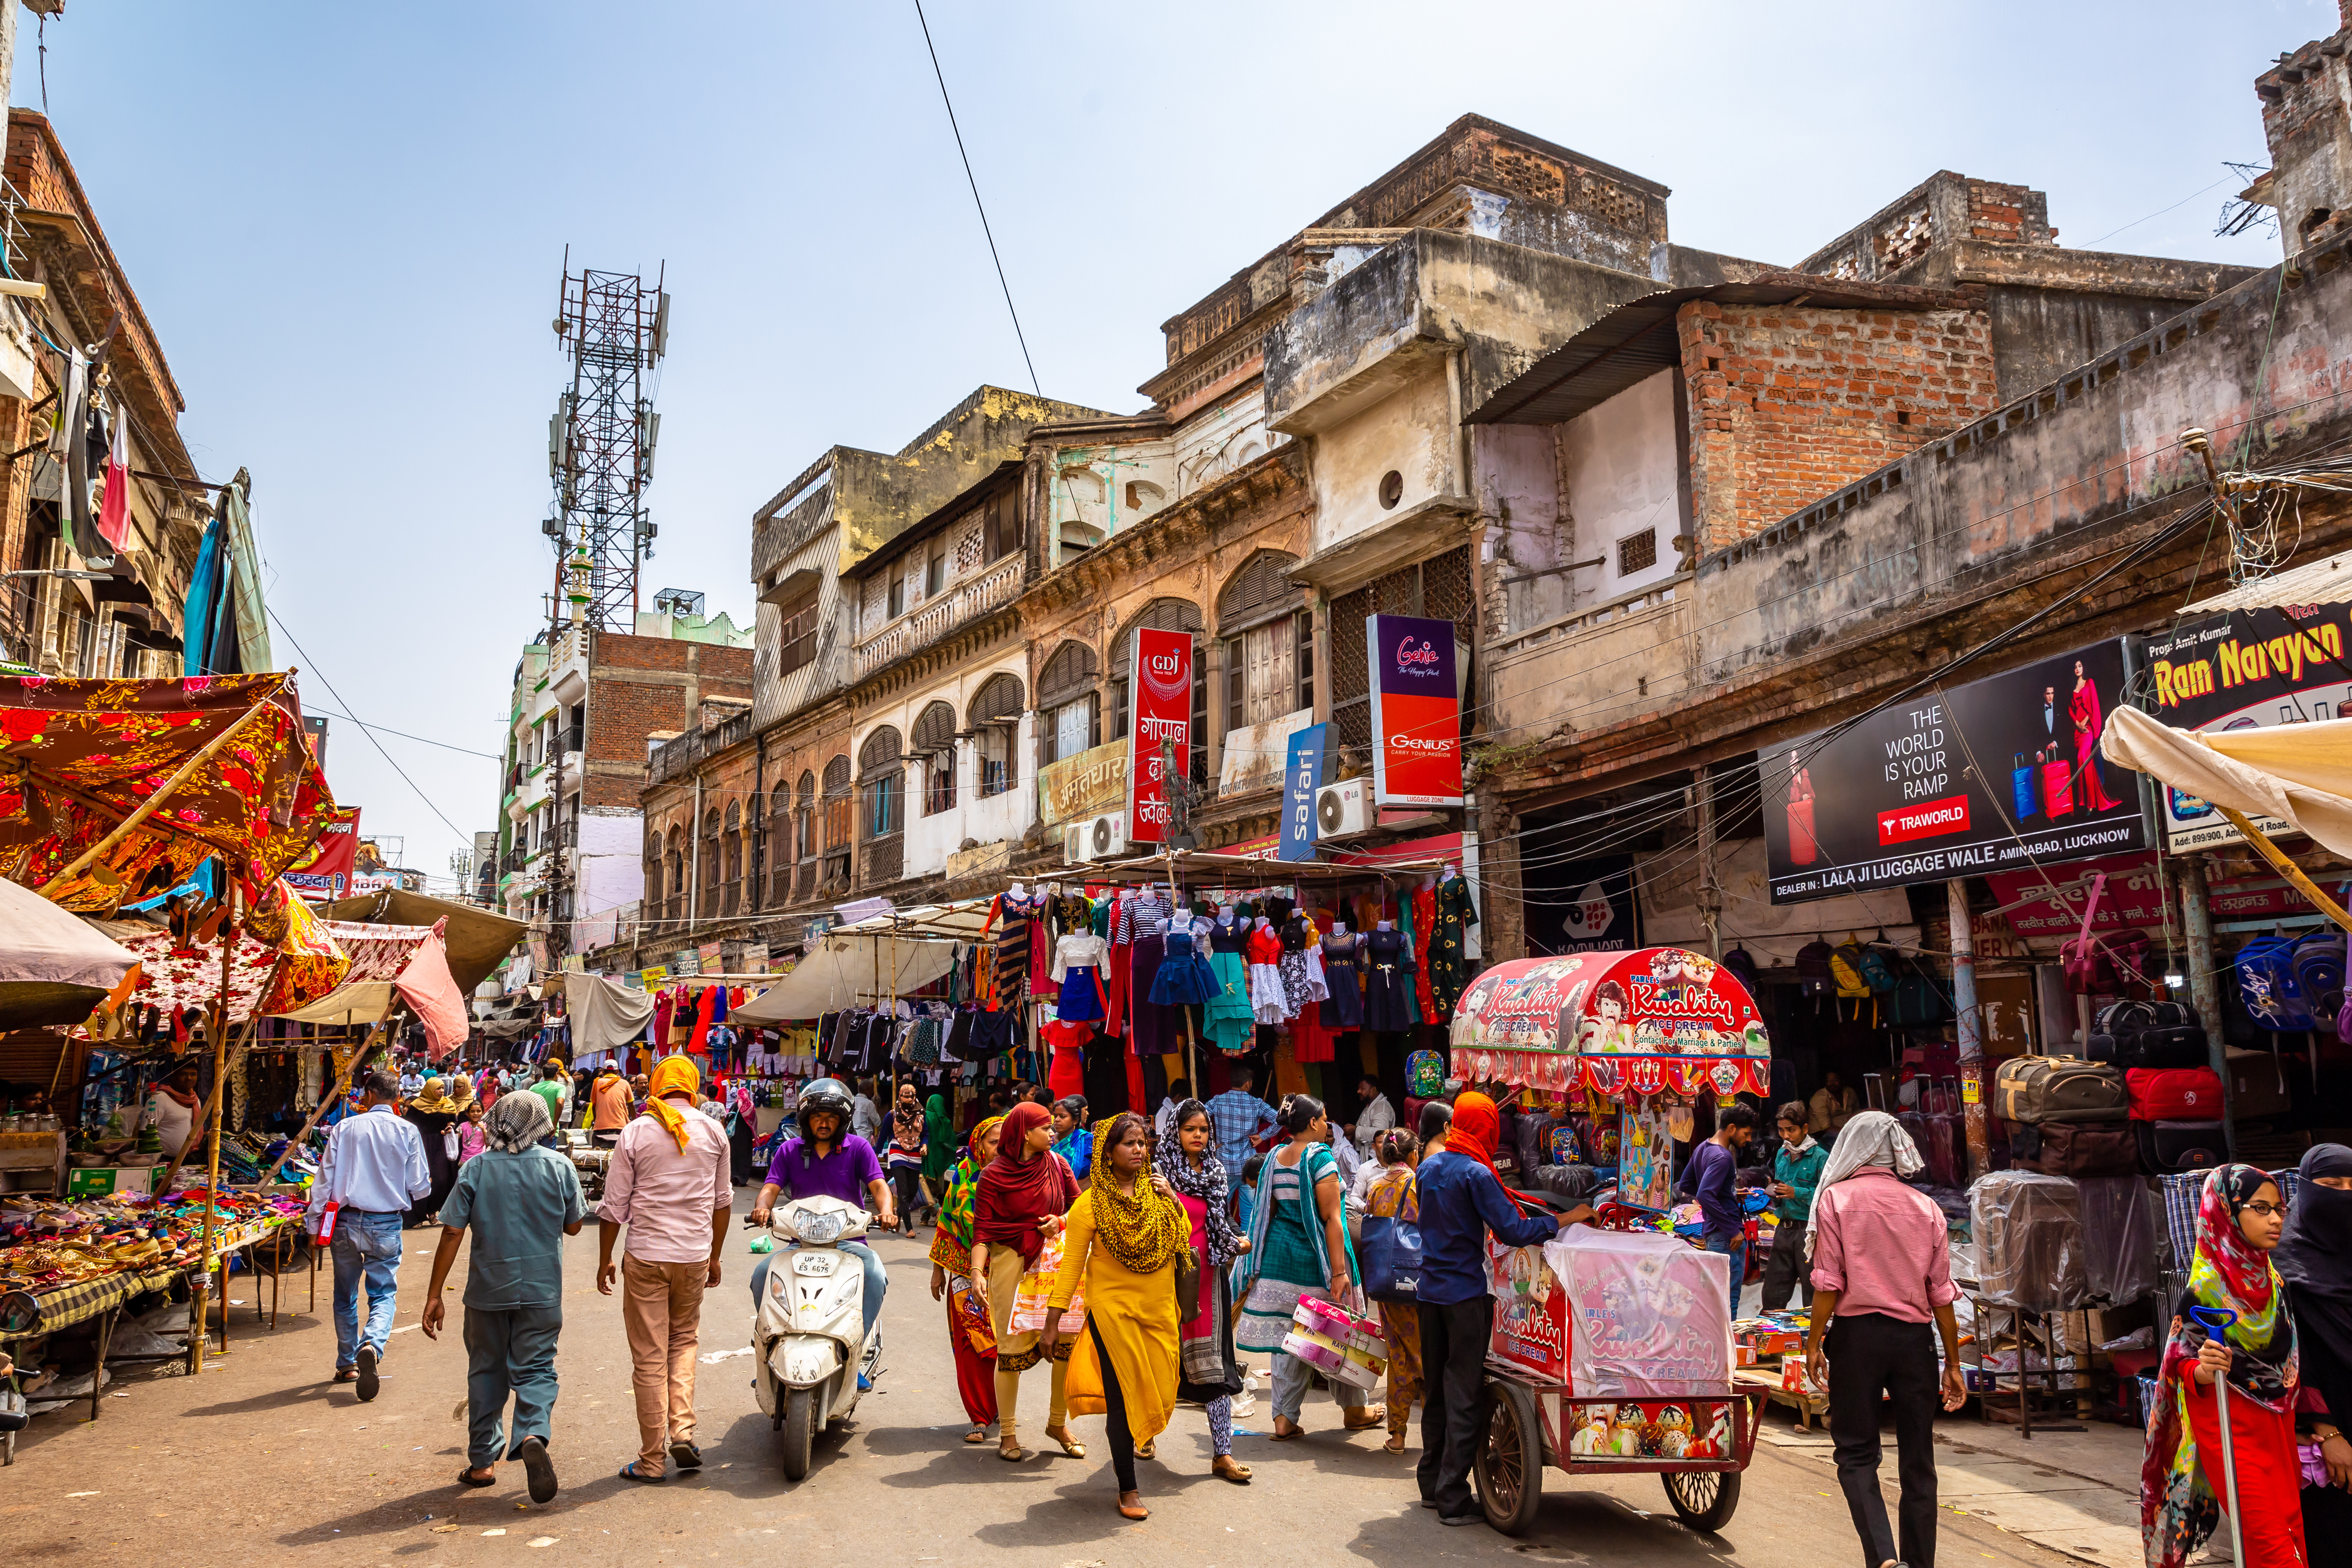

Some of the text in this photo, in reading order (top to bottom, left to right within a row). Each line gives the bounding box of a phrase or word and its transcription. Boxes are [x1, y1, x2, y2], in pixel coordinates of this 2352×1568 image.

[1397, 636, 1439, 665] Genie
[2149, 624, 2232, 658] Prop: Amit Kumar
[1152, 655, 1179, 675] GDJ
[1408, 667, 1425, 677] Happy
[2154, 622, 2344, 708] Ram Narayan
[1141, 709, 1187, 743] गोपाल
[1909, 705, 1942, 729] THE
[1886, 728, 1944, 759] WORLD
[1885, 751, 1946, 782] IS YOUR
[1221, 783, 1232, 795] 100
[1233, 777, 1261, 792] NATURAL
[1294, 750, 1313, 840] safari
[1904, 773, 1948, 800] RAMP
[1900, 806, 1963, 831] TRAWORLD
[2175, 837, 2191, 847] Add:
[2192, 831, 2223, 843] 899/900,
[2266, 821, 2290, 831] Road,
[1777, 882, 1806, 896] DEALER
[1823, 869, 1855, 888] LALA
[1858, 866, 1869, 882] JI
[1873, 855, 1945, 880] LUGGAGE
[1947, 846, 1995, 868] WALE
[1999, 840, 2062, 860] AMINABAD,
[2065, 828, 2130, 849] LUCKNOW
[2046, 913, 2071, 927] वाली
[2098, 909, 2109, 922] के
[1558, 939, 1624, 955] KAMILIANT
[1630, 974, 1660, 984] PARLE'S
[1487, 982, 1563, 1026] Kwality
[1631, 984, 1735, 1026] Kwality
[1497, 1021, 1540, 1032] ICE CREAM
[1654, 1019, 1713, 1031] ICE CREAM
[1634, 1035, 1742, 1048] Contact For Marriage & Parties
[1303, 1327, 1315, 1336] RAYA
[1495, 1297, 1562, 1359] Kwality
[1332, 1340, 1347, 1352] RAYA
[1508, 1339, 1547, 1363] ICE CREAM
